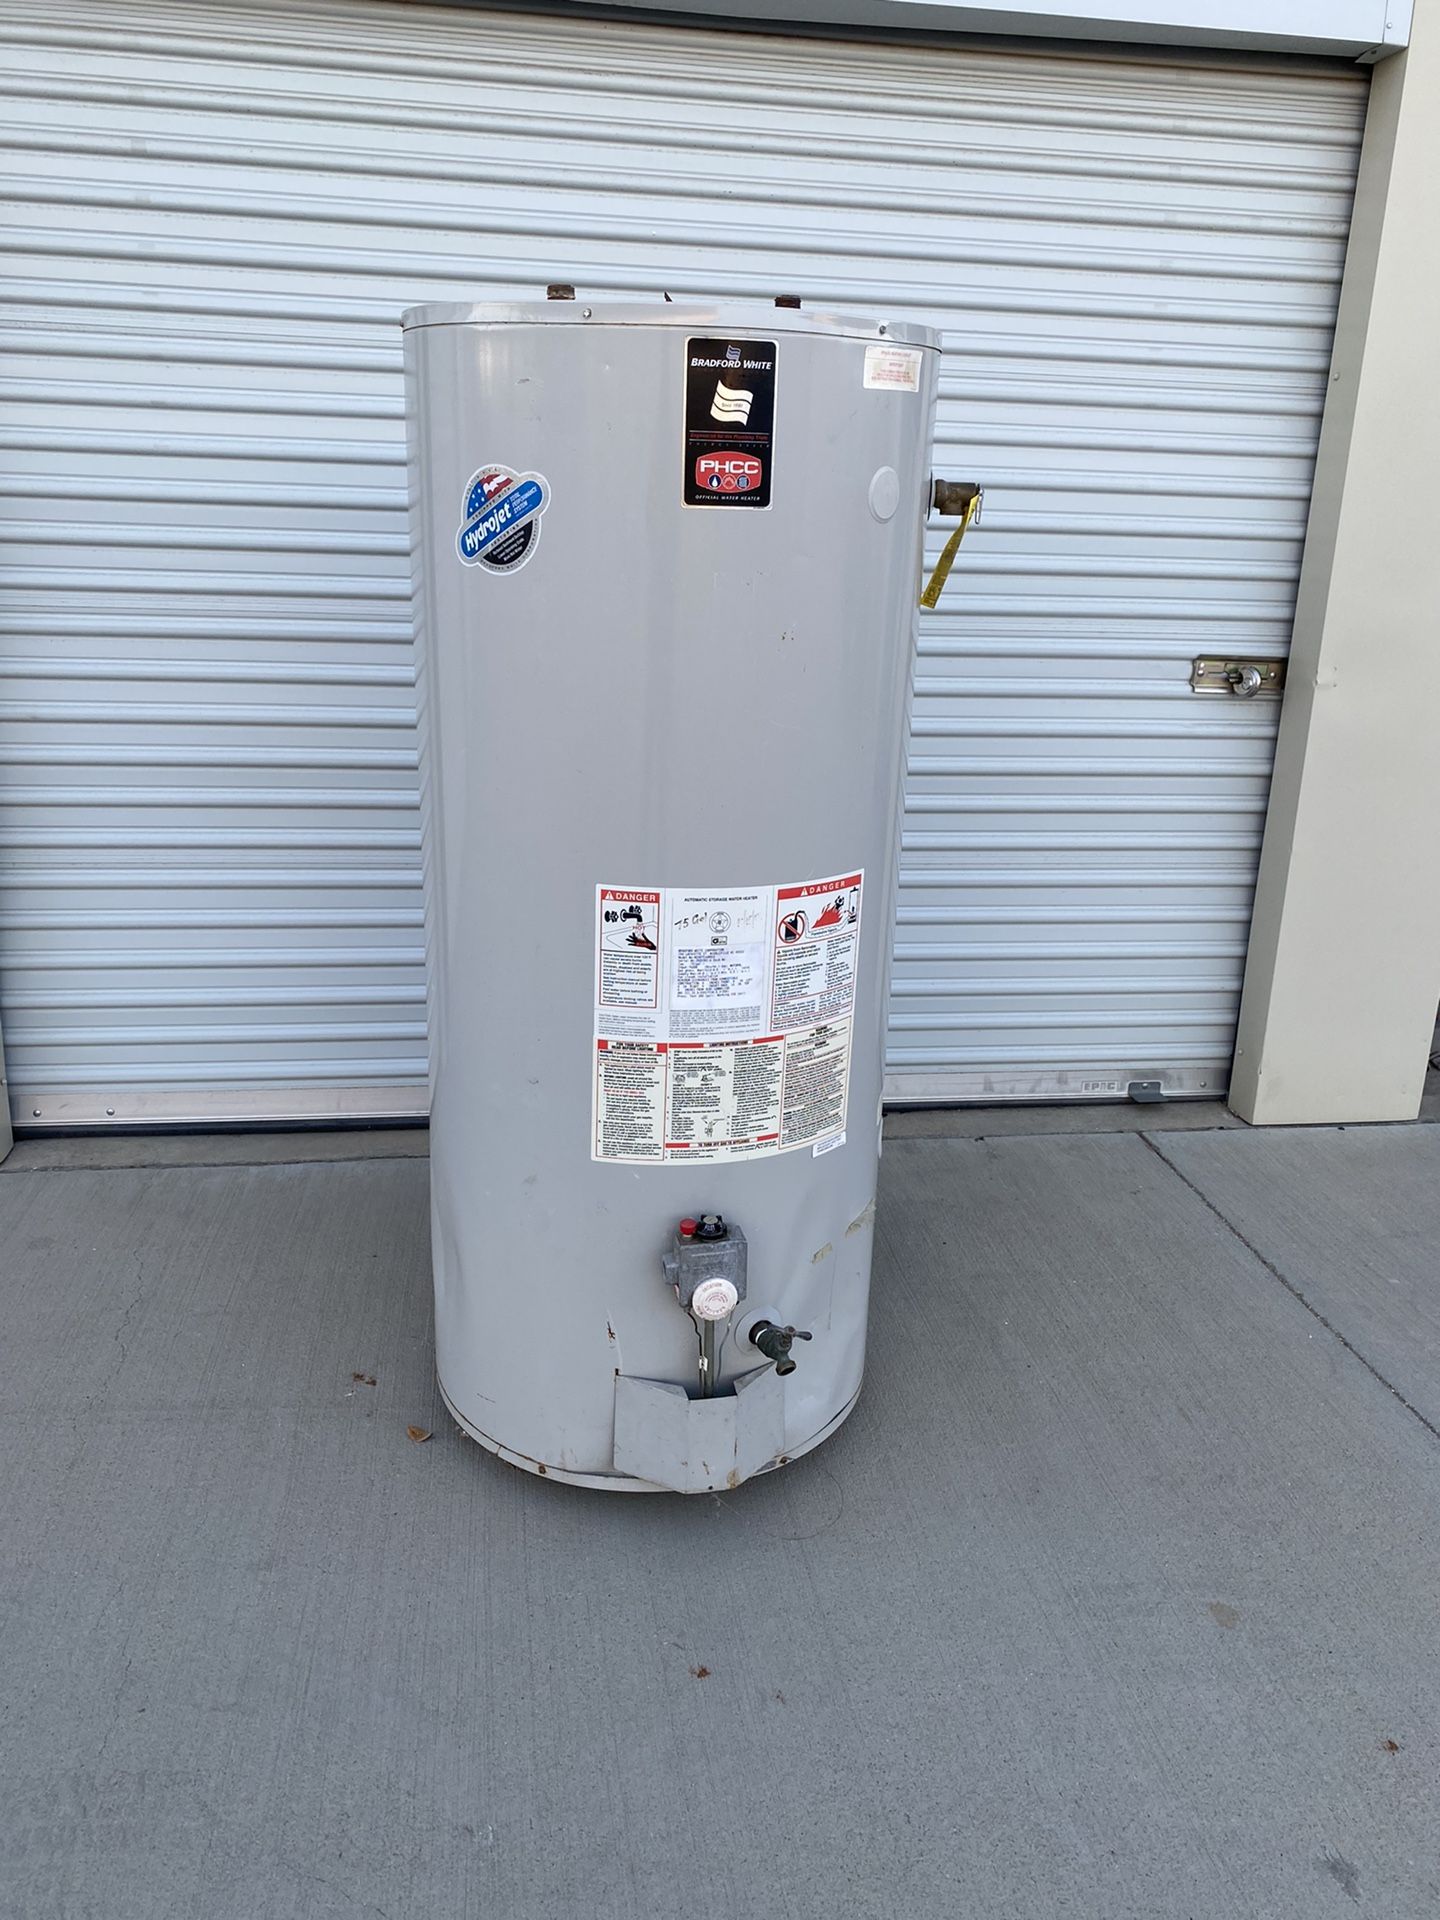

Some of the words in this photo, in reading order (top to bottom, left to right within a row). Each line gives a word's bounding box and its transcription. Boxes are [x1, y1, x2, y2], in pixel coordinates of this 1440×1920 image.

[691, 358, 741, 368] BRADFORD
[743, 360, 773, 370] WHITE
[700, 460, 759, 474] PHCC
[465, 502, 511, 552] Hydrojet
[809, 880, 846, 894] DANGER
[615, 892, 656, 902] DANGER
